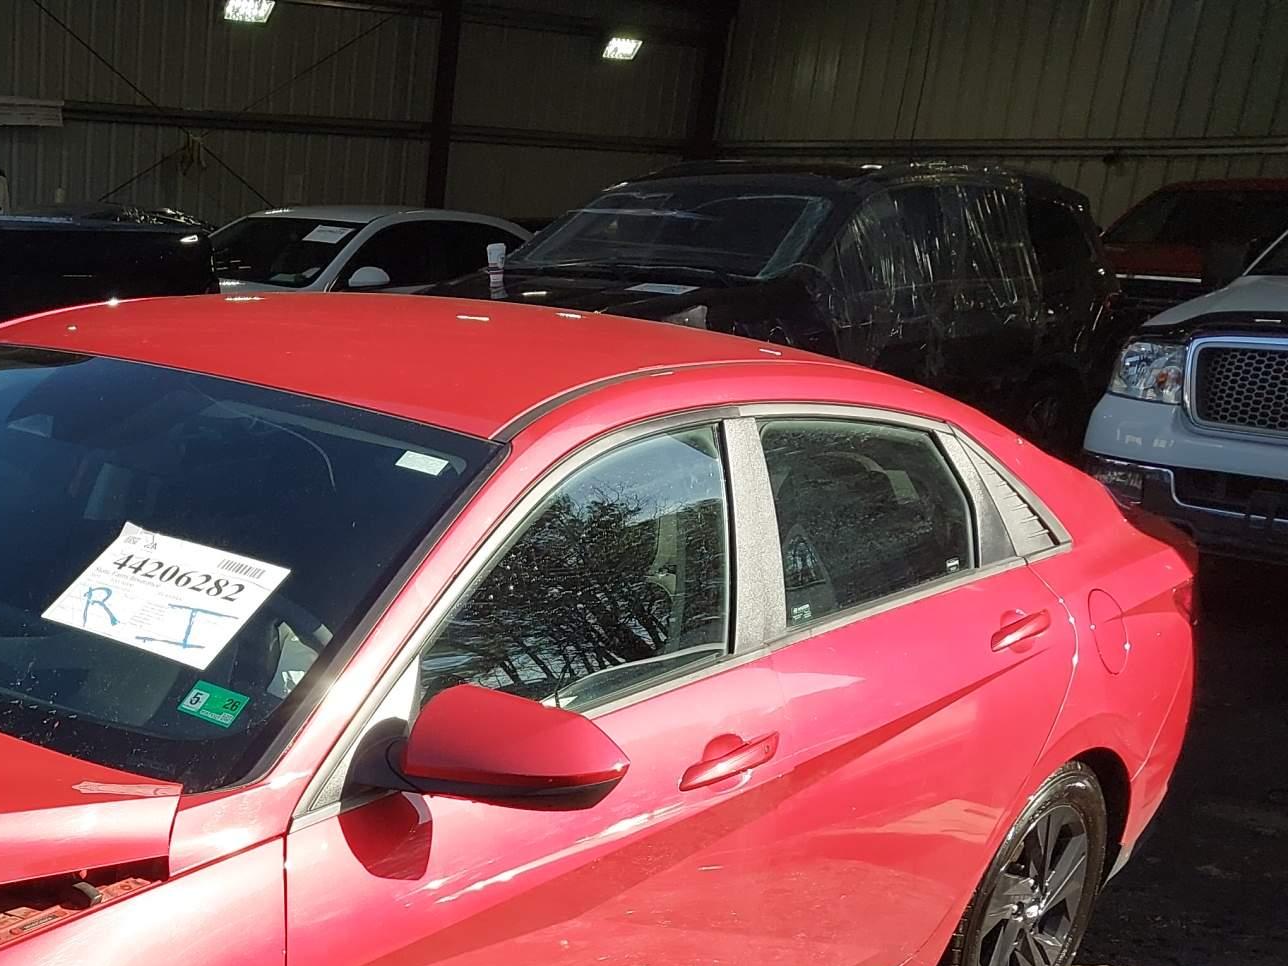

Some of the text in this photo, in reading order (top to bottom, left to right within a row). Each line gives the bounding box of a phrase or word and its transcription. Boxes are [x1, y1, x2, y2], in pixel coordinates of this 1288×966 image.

[112, 553, 245, 602] 44206282
[83, 586, 120, 627] R
[190, 691, 241, 712] 5 26
